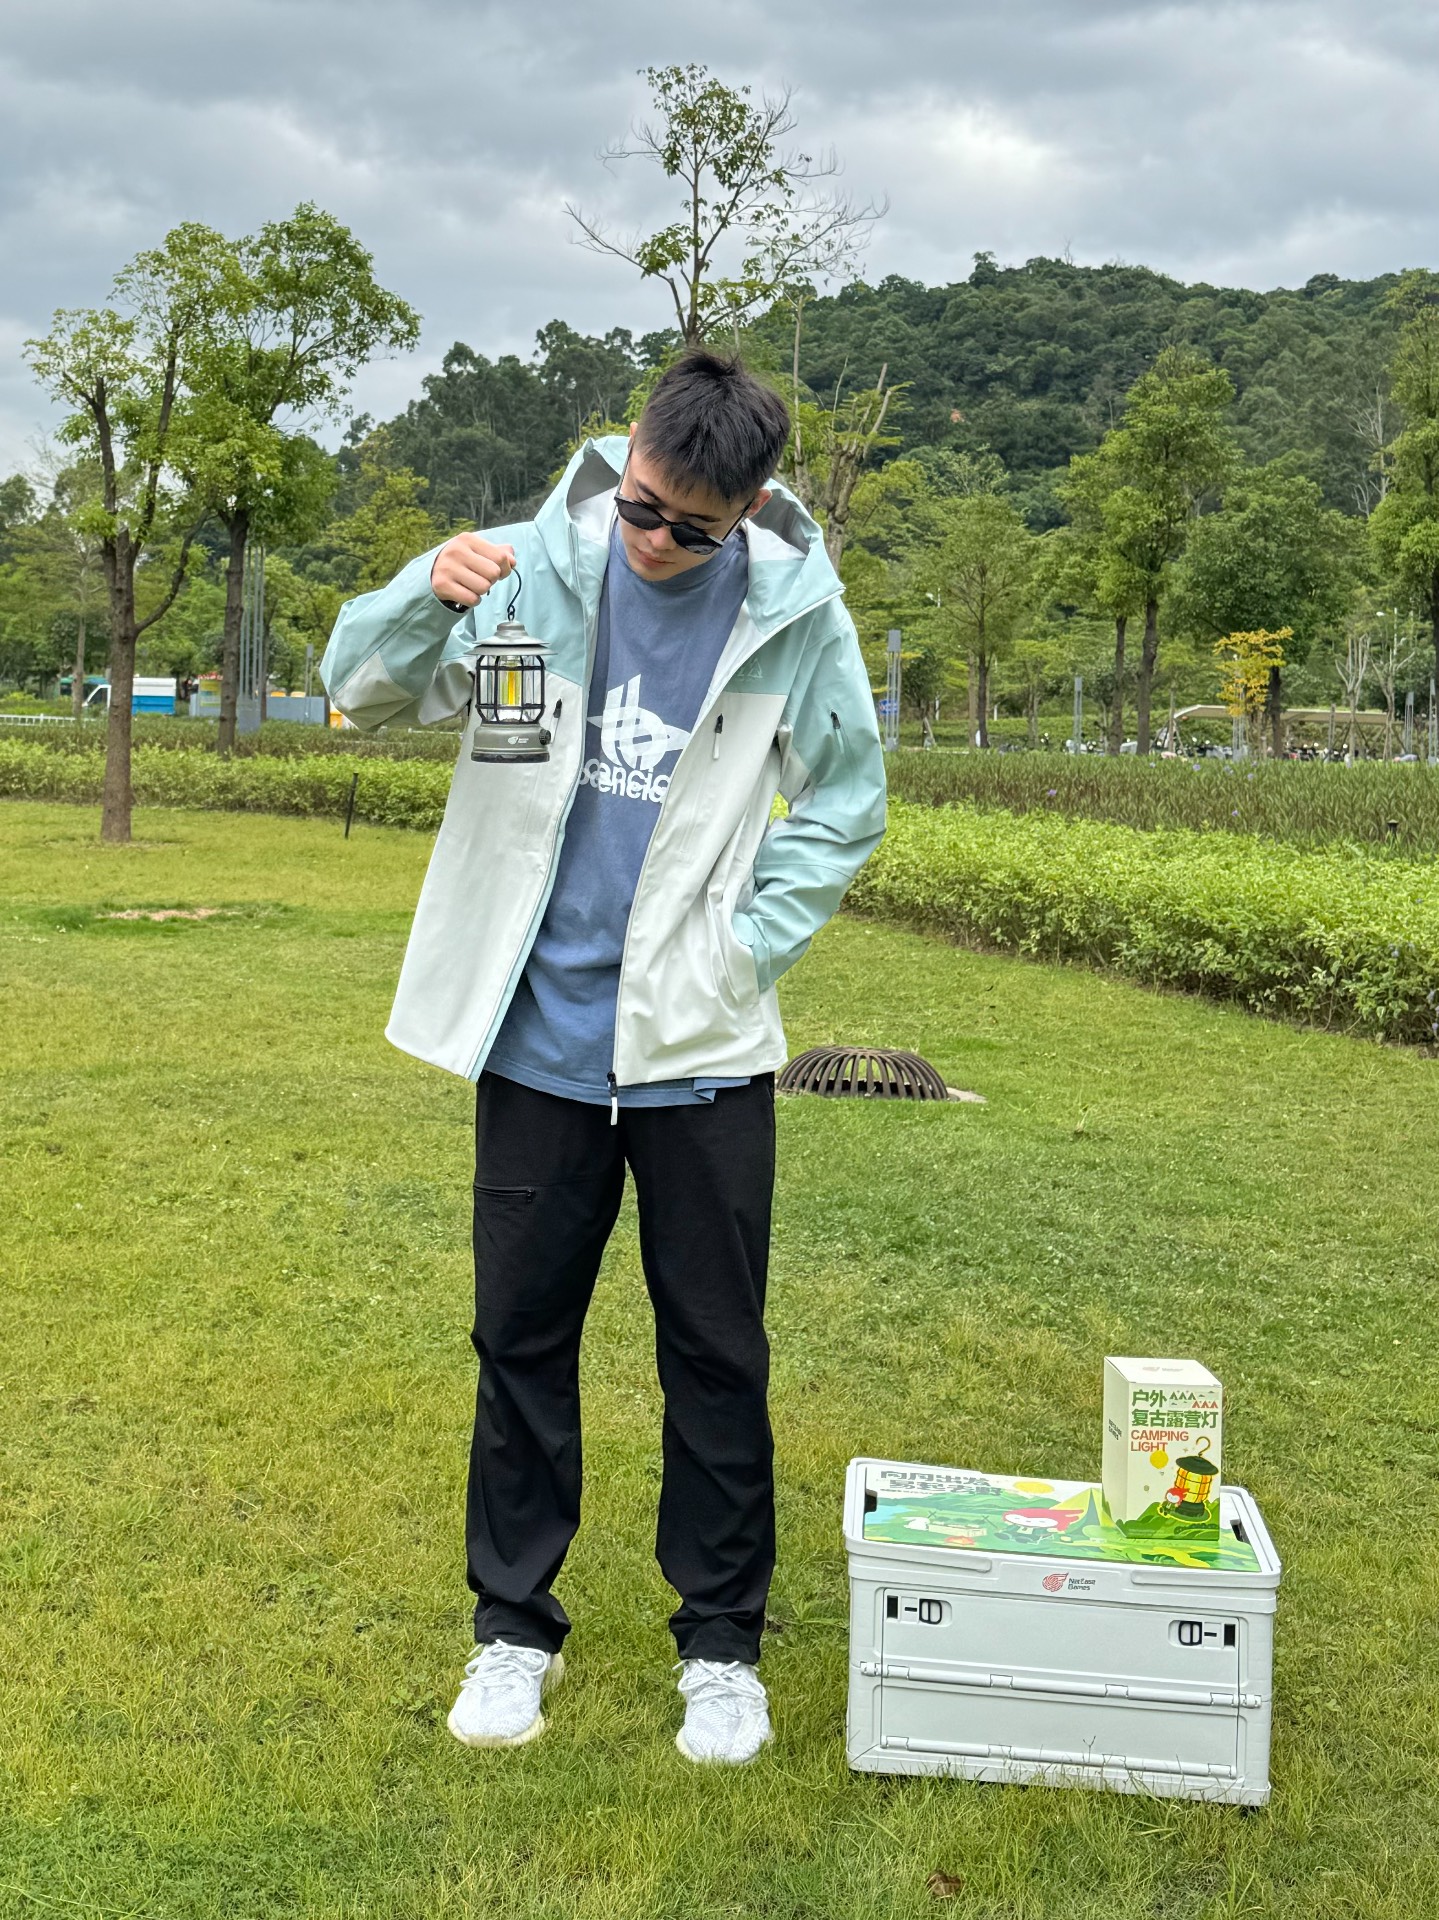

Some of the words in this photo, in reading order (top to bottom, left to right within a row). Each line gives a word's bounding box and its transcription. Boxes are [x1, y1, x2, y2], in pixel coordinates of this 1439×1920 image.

[1132, 1389, 1167, 1408] 户外
[1131, 1408, 1219, 1429] 复古露营灯
[1130, 1429, 1190, 1442] CAMPING
[1130, 1441, 1169, 1453] LIGHT
